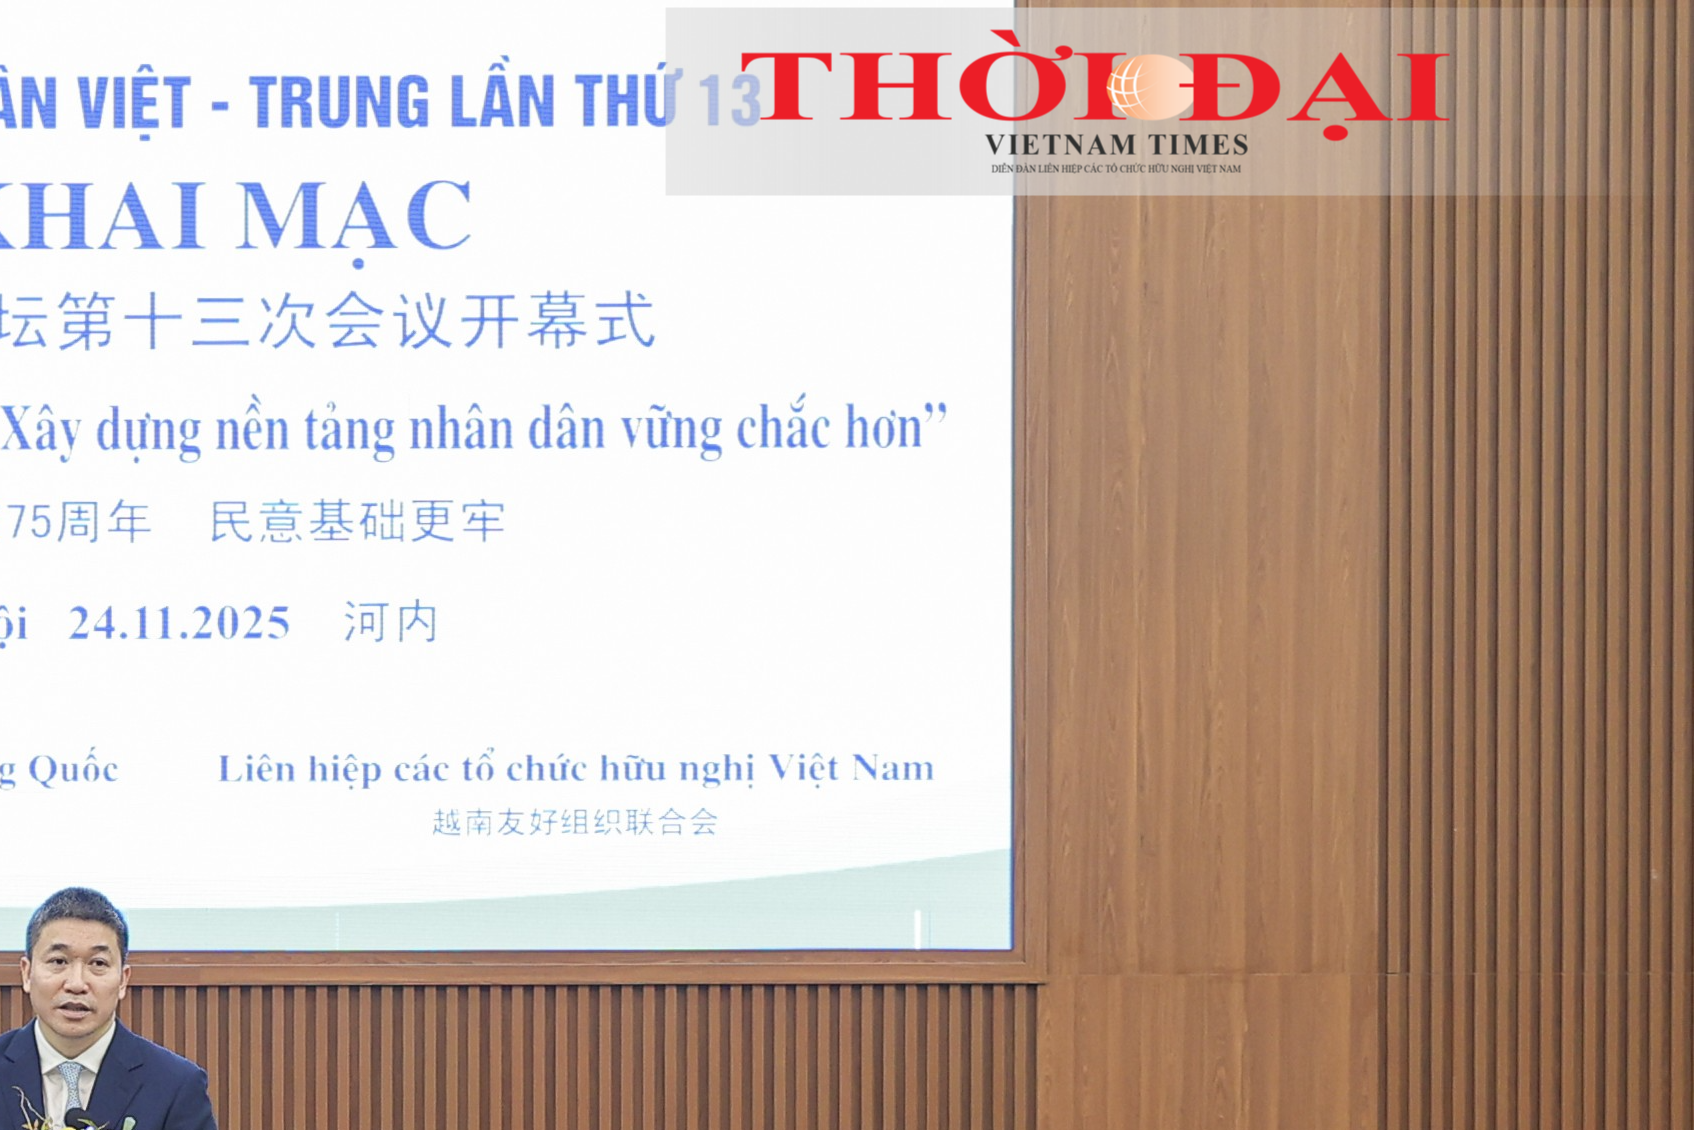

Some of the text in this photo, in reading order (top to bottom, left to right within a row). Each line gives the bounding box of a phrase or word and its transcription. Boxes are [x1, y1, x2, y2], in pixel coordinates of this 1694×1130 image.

[77, 64, 191, 142] VIỆT
[249, 74, 429, 128] TRUNG
[452, 55, 554, 127] LẦN
[575, 62, 682, 127] THỨ
[702, 74, 761, 127] 13
[236, 180, 472, 270] MẠC
[1, 404, 77, 463] Xây
[97, 405, 202, 464] dựng
[216, 394, 289, 451] nền
[306, 402, 396, 462] tảng
[410, 403, 514, 450] nhân
[528, 402, 605, 450] dân
[621, 404, 723, 462] vững
[737, 393, 831, 449] chắc
[846, 401, 947, 449] hơn”
[211, 498, 506, 544] 民意基础更牢
[69, 603, 291, 641] 24.11.2025
[344, 598, 437, 644] 河内
[29, 745, 119, 790] Quốc
[219, 747, 935, 790] Liên hiệp các tổ chức hữu nghị Việt Nam
[432, 806, 719, 837] 越南友好组织联合会
